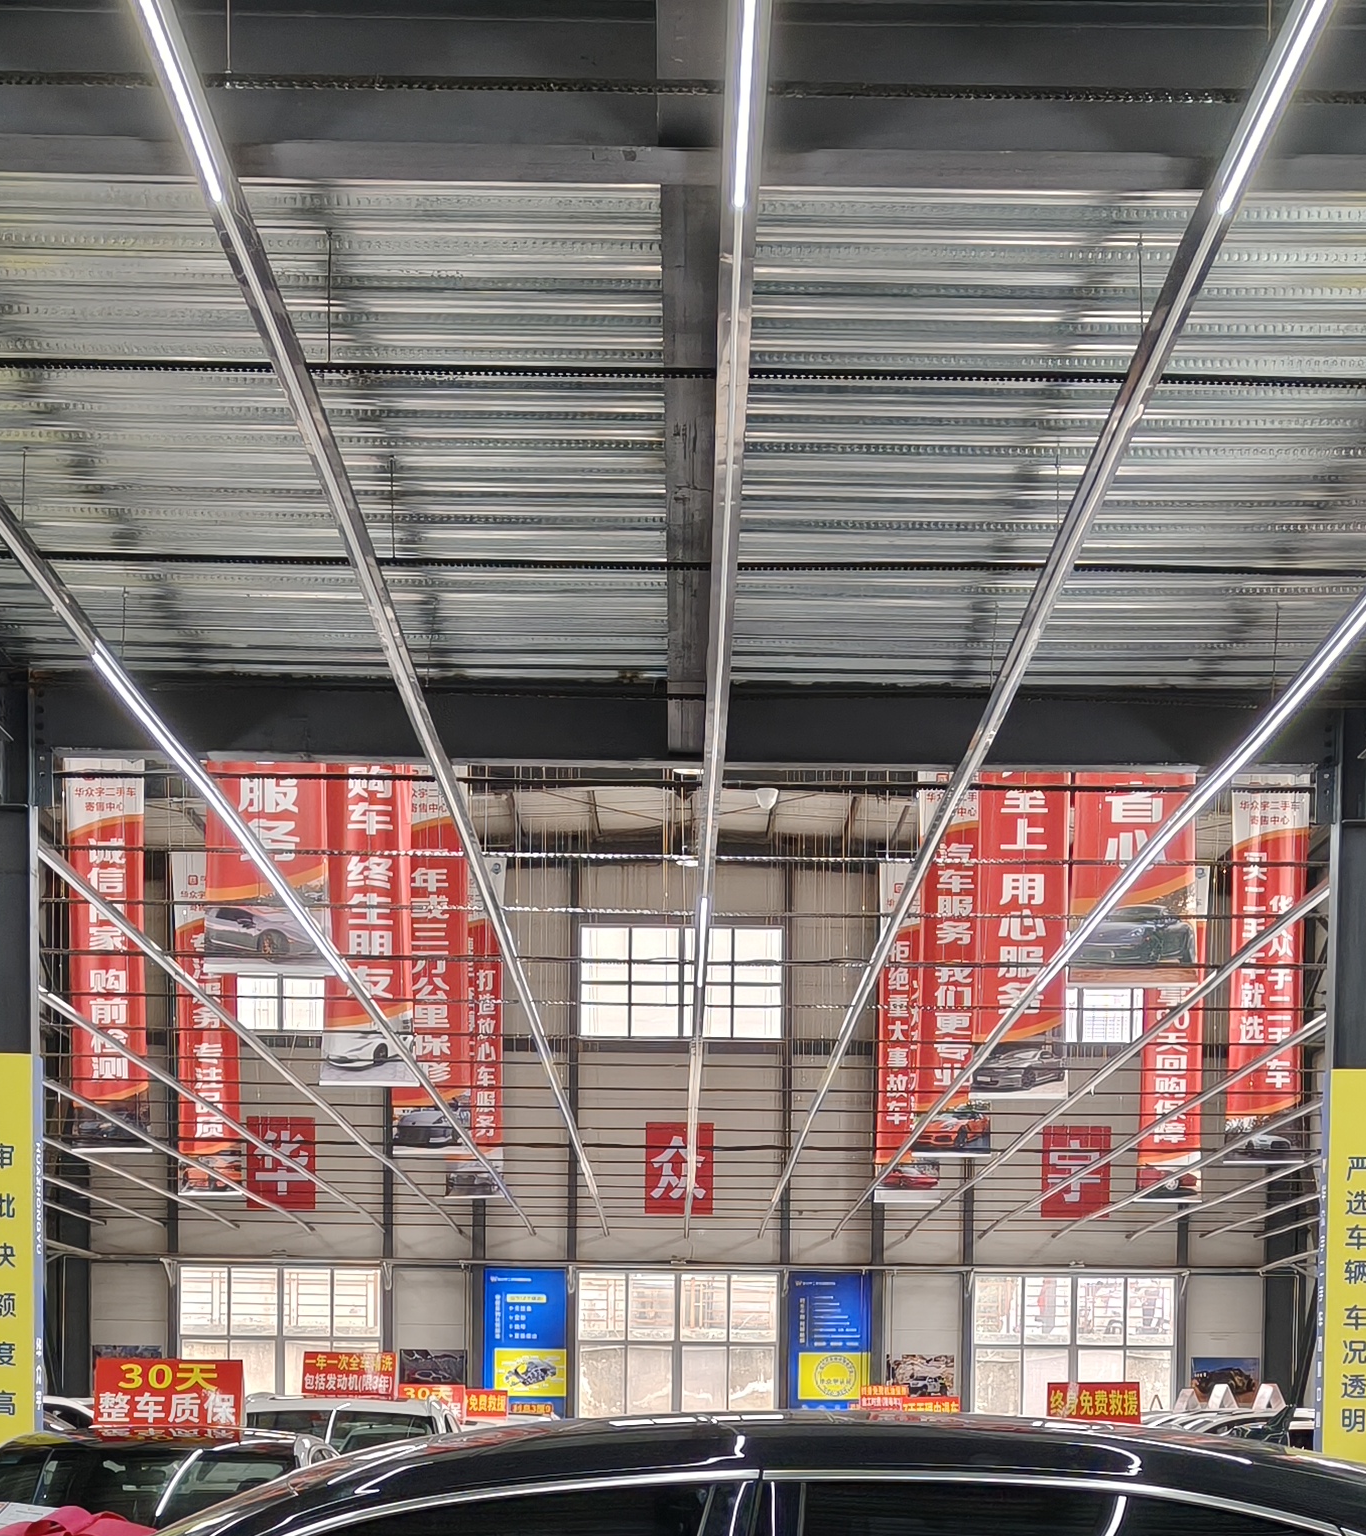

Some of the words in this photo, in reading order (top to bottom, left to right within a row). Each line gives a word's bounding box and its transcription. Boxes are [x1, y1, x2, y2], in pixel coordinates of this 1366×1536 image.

[348, 766, 393, 835] 购车
[346, 856, 393, 999] 终生朋友
[937, 843, 974, 945] 汽车服务
[997, 873, 1045, 1016] 用心服务
[89, 969, 129, 1081] 购前检测
[885, 940, 911, 1125] 拒绝重大事故车
[933, 960, 974, 1087] 我们更专业
[253, 1130, 309, 1196] 华
[651, 1135, 713, 1199] 众
[98, 1391, 236, 1425] 整车质保
[118, 1363, 218, 1391] 30天
[304, 1373, 393, 1392] 包括发动机(限3年)
[1050, 1390, 1139, 1416] 终身免费救援
